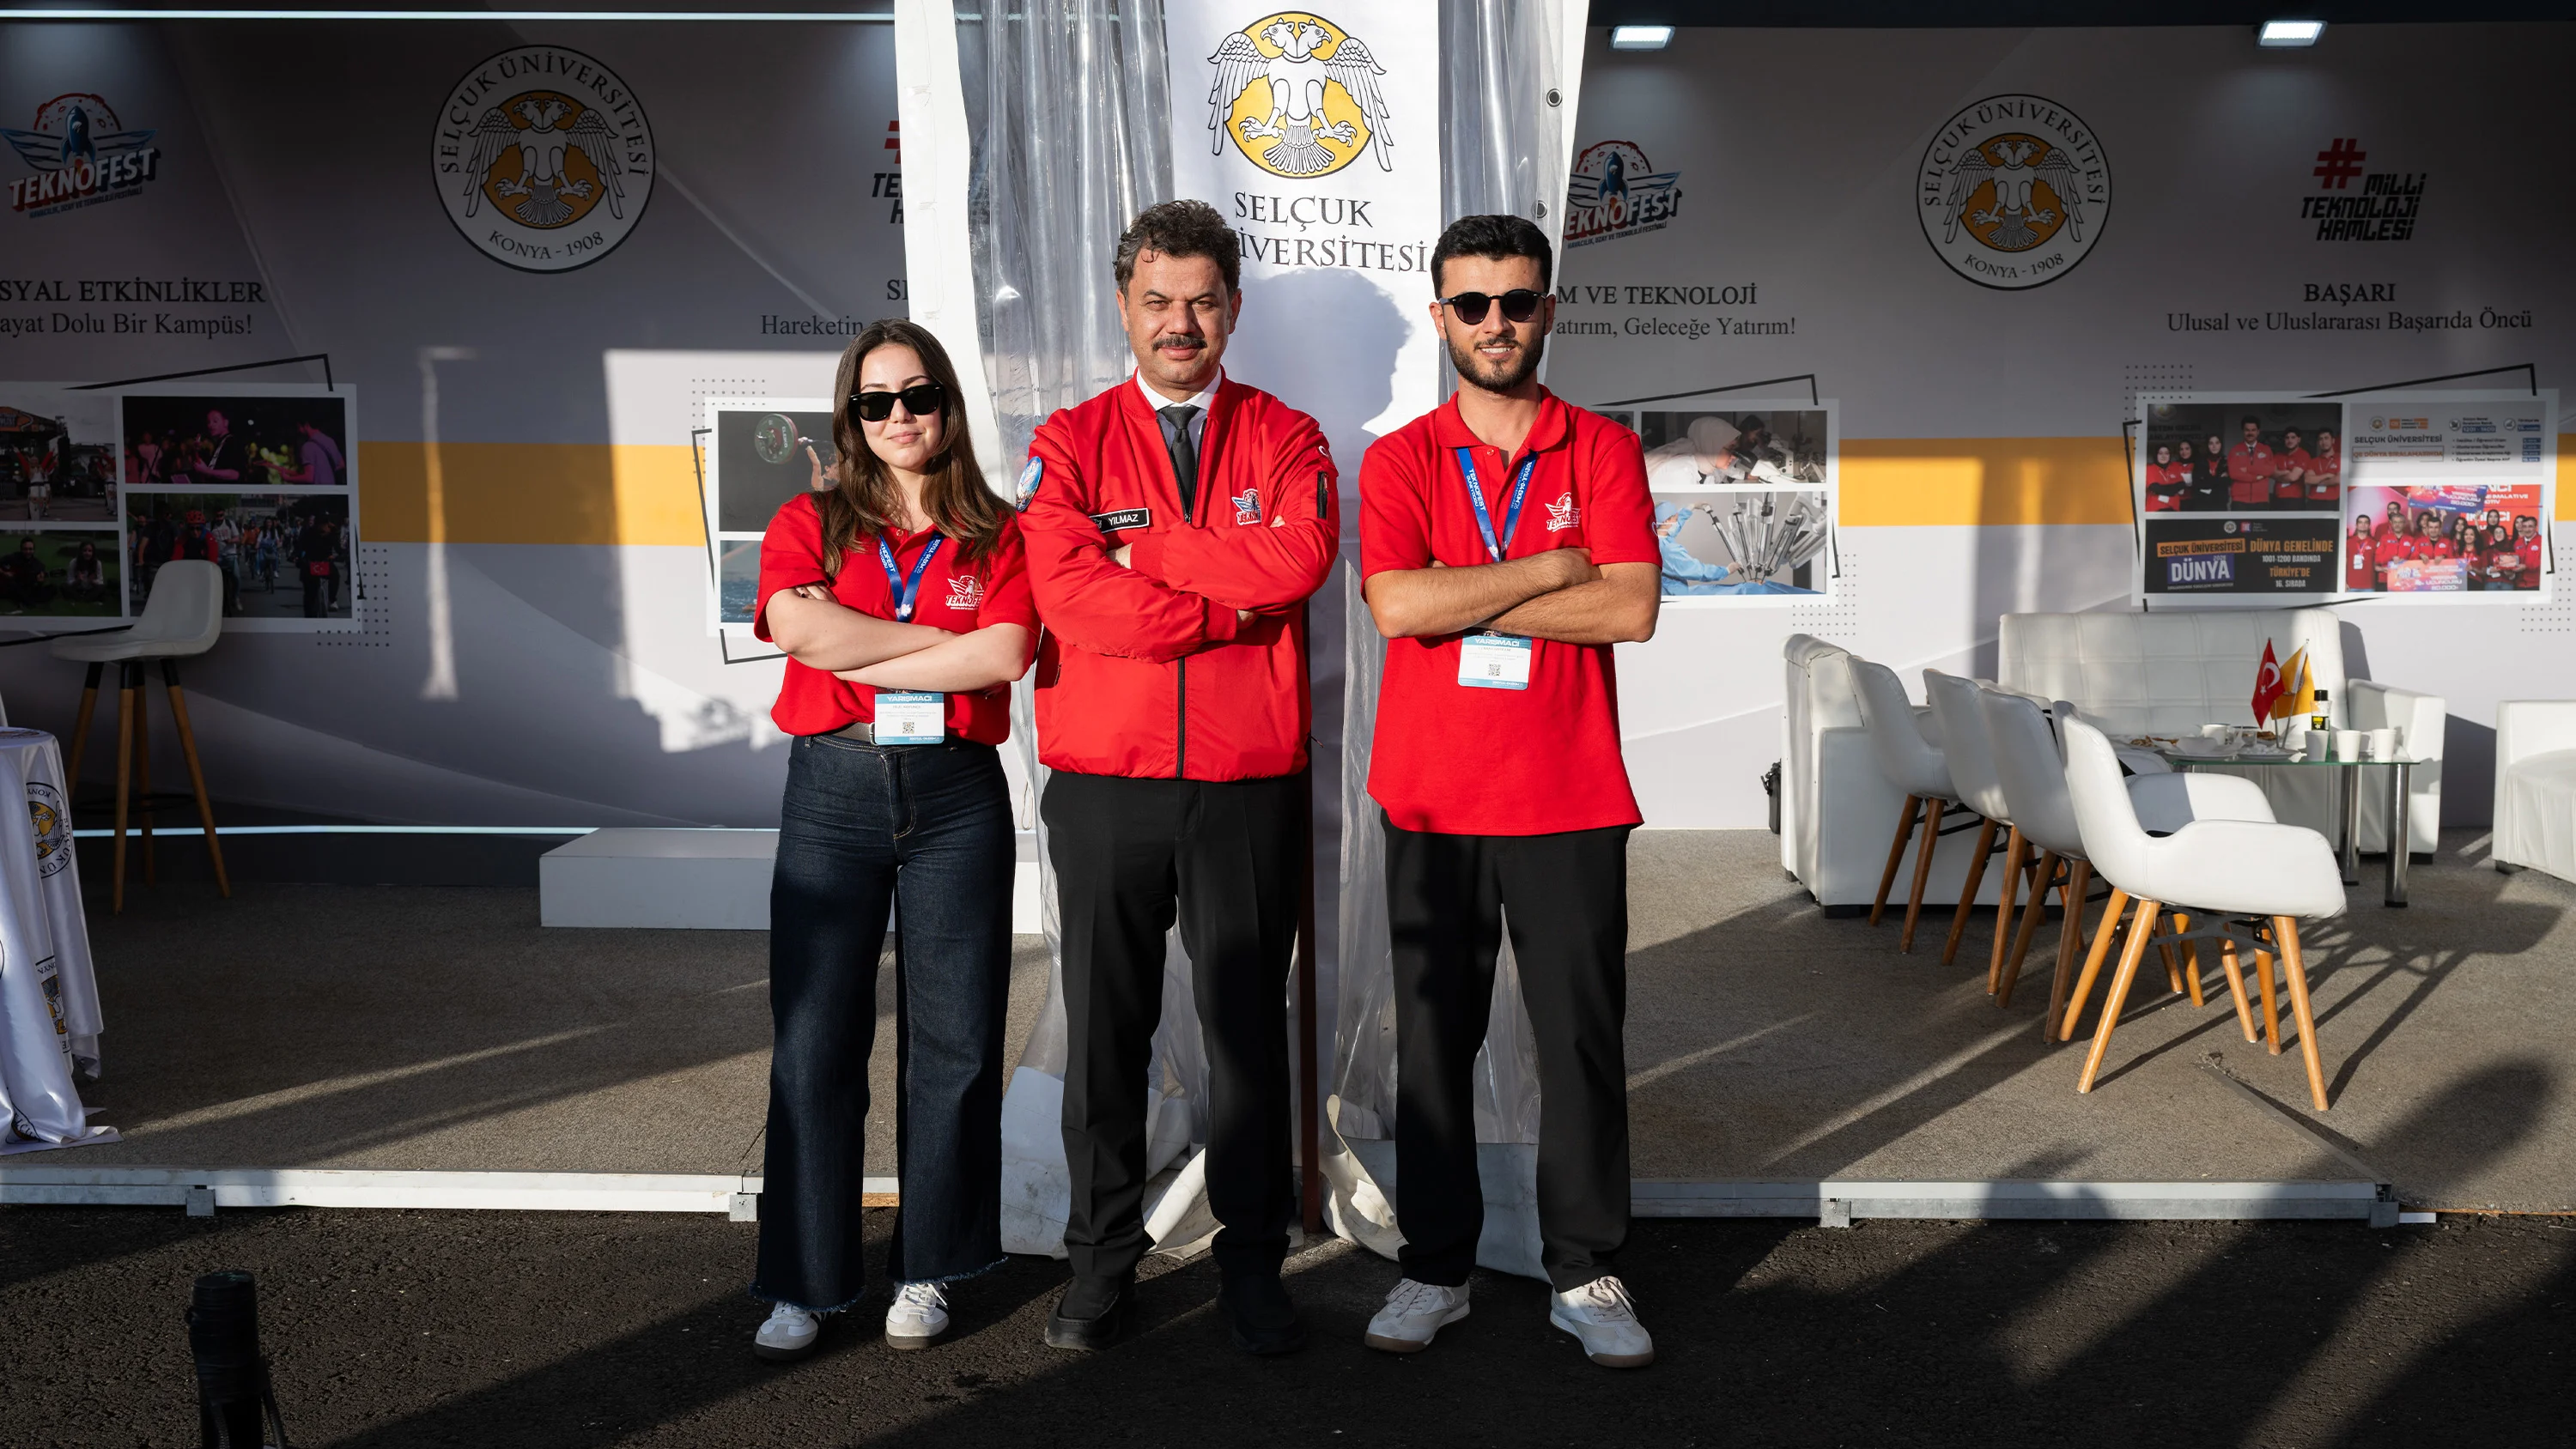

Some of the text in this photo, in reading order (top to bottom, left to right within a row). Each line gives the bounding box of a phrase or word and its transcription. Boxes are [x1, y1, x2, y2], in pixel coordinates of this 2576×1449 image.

[440, 52, 650, 177] SELÇUK ÜNİVERSİTESİ
[1924, 100, 2106, 207] SELÇUK ÜNİVERSİTESİ
[9, 148, 161, 212] TEKNOFEST
[1235, 191, 1373, 232] SELÇUK
[1564, 187, 1682, 240] EKNOFEST
[2301, 197, 2421, 219] TEKNOLOJİ
[2317, 219, 2415, 241] HAMLESİ
[489, 230, 552, 259] KONYA
[567, 232, 604, 257] 1908
[1240, 227, 1428, 273] İVERSİTESİ
[1965, 253, 2019, 278] KONYA
[2031, 253, 2064, 276] 1908
[79, 276, 266, 303] ETKİNLİKLER
[1585, 286, 1618, 304] VE
[1625, 282, 1758, 305] TEKNOLOJİ
[2304, 283, 2397, 307] BAŞARI
[52, 313, 106, 334] Dolu
[113, 313, 147, 334] Bir
[155, 313, 252, 340] Kampüs!
[761, 314, 863, 336] Hareketin
[1554, 317, 1796, 340] atırım, Geleceğe Yatırım!
[2167, 306, 2532, 334] Ulusal ve Uluslararası Başarıda Öncü
[2354, 433, 2443, 445] SELÇUK ÜNİVERSİTESİ
[1468, 468, 1486, 512] TEKNOFEST
[1108, 514, 1139, 526] YILMAZ
[2160, 540, 2243, 556] SELÇUK ÜNİVERSİTESİ
[2250, 537, 2334, 553] DÜNYA GENELİNDE
[2171, 557, 2230, 582] DÜNYA
[945, 594, 982, 607] TEKNOFE
[1474, 638, 1520, 647] YARIŞMACI
[27, 788, 51, 798] KONY
